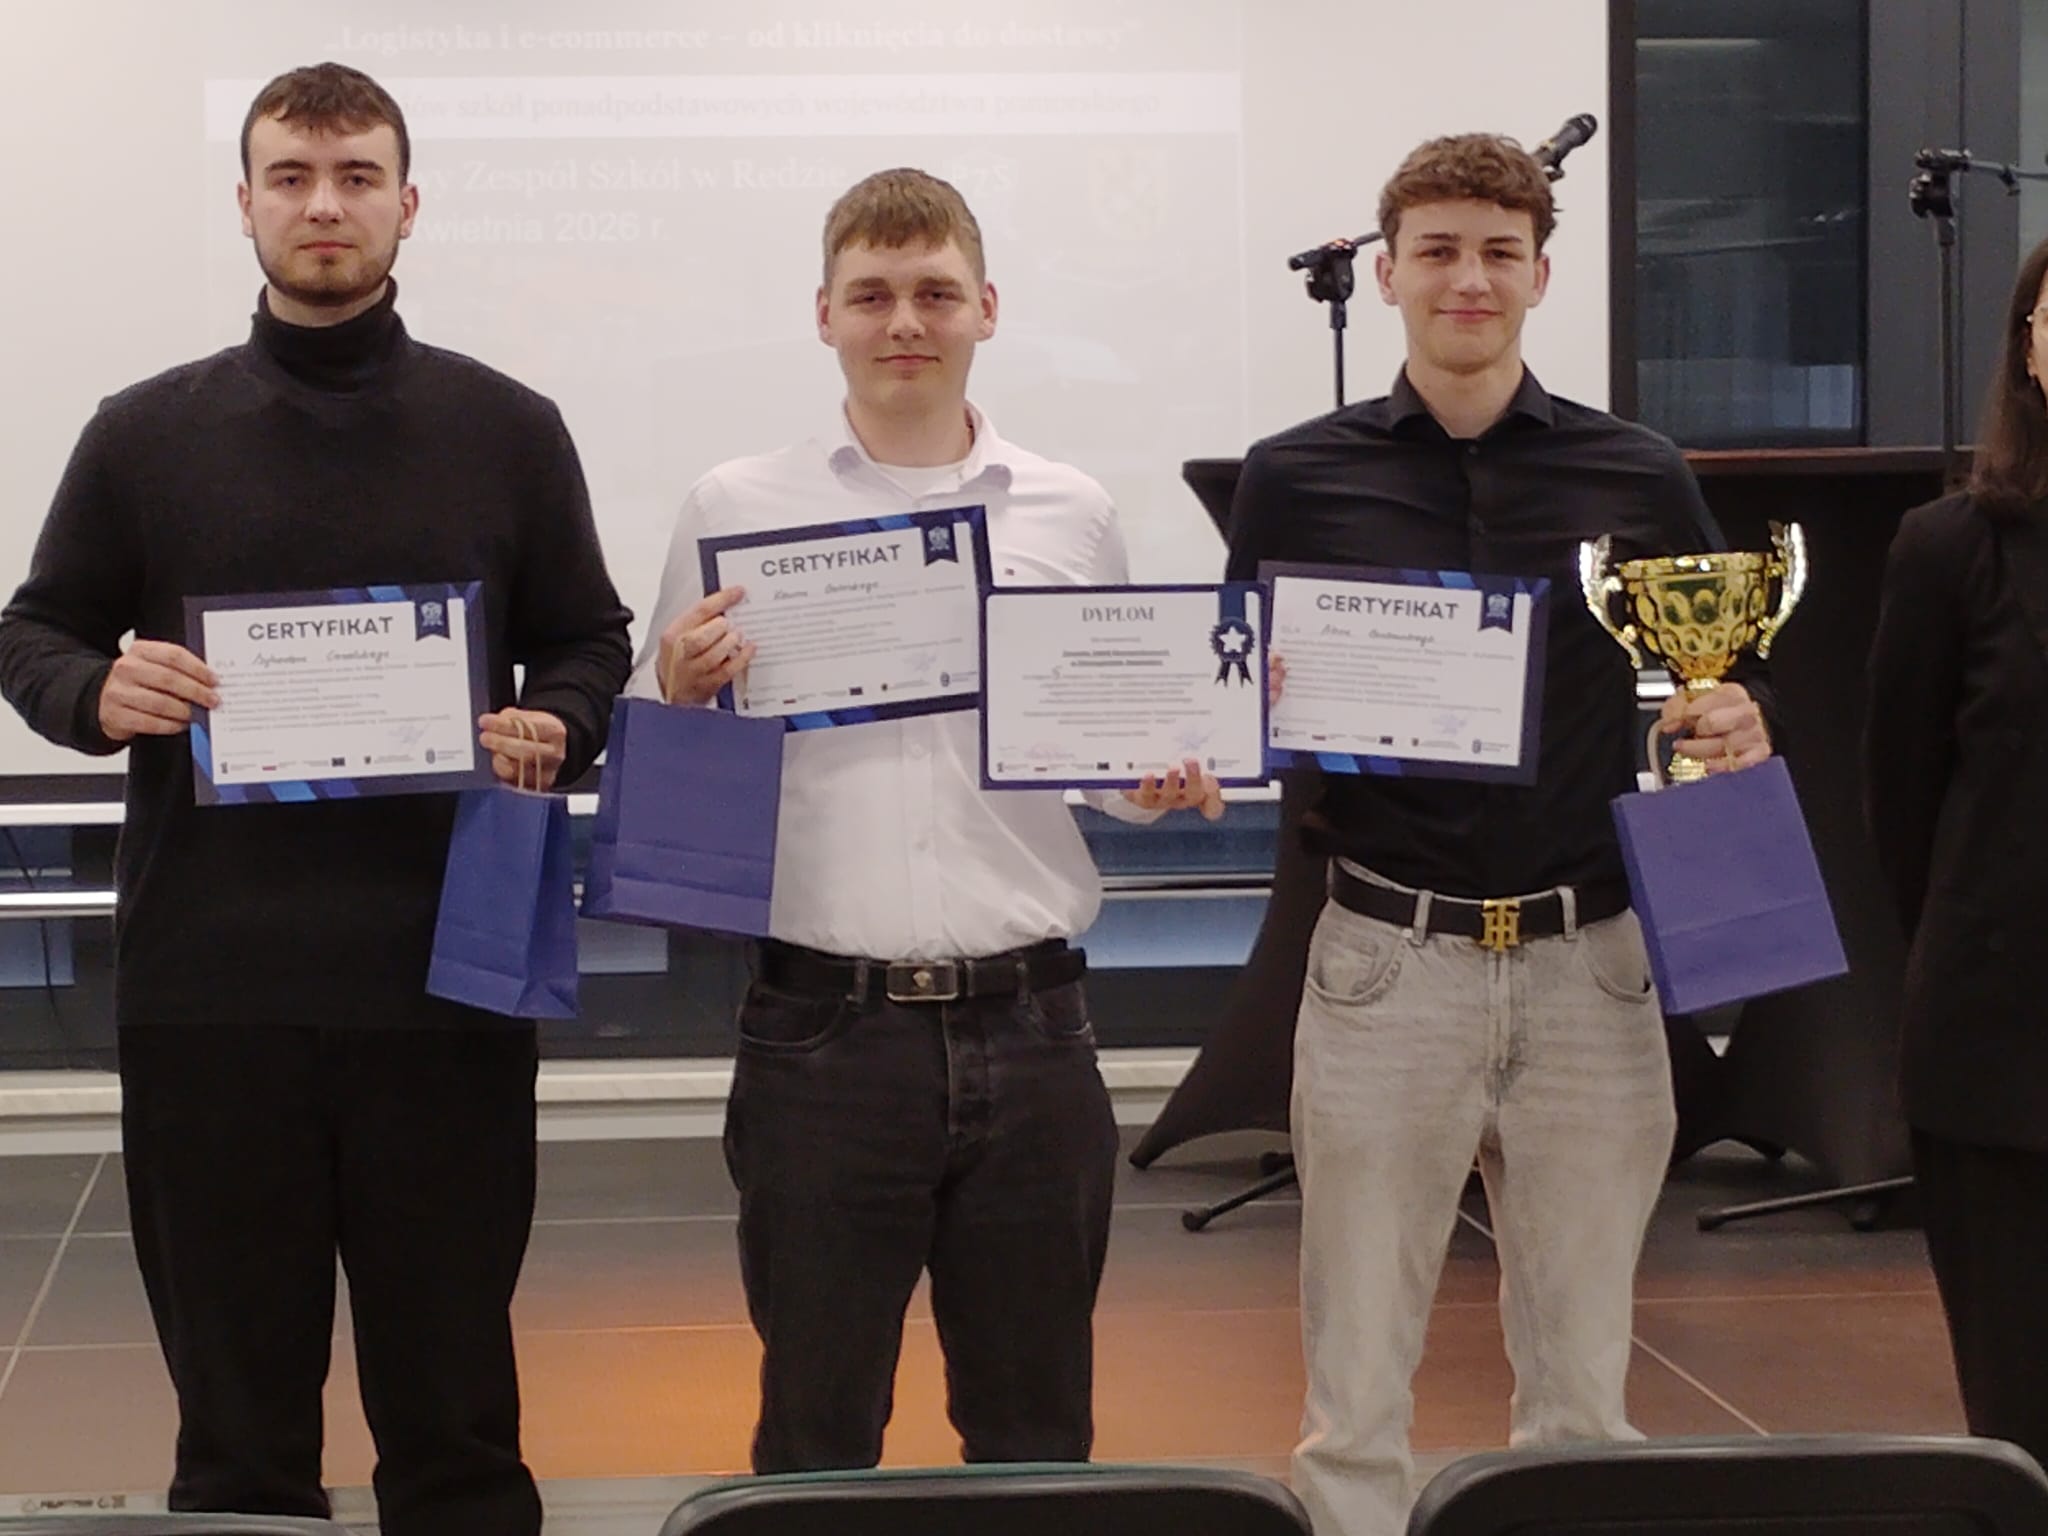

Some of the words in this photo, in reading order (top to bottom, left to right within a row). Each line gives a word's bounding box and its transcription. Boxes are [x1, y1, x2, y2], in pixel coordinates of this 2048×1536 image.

[518, 28, 710, 49] e-commerce
[746, 20, 784, 48] od
[793, 19, 944, 54] kliknięcia
[953, 18, 991, 48] do
[463, 159, 577, 197] Zespół
[588, 157, 679, 192] Szkół
[686, 169, 718, 190] w
[555, 212, 639, 242] 2026
[761, 544, 901, 577] CERTYFIKAT
[1082, 606, 1154, 621] DYPLOM
[1316, 593, 1459, 620] CERTYFIKAT
[248, 616, 393, 641] CERTYFIKAT
